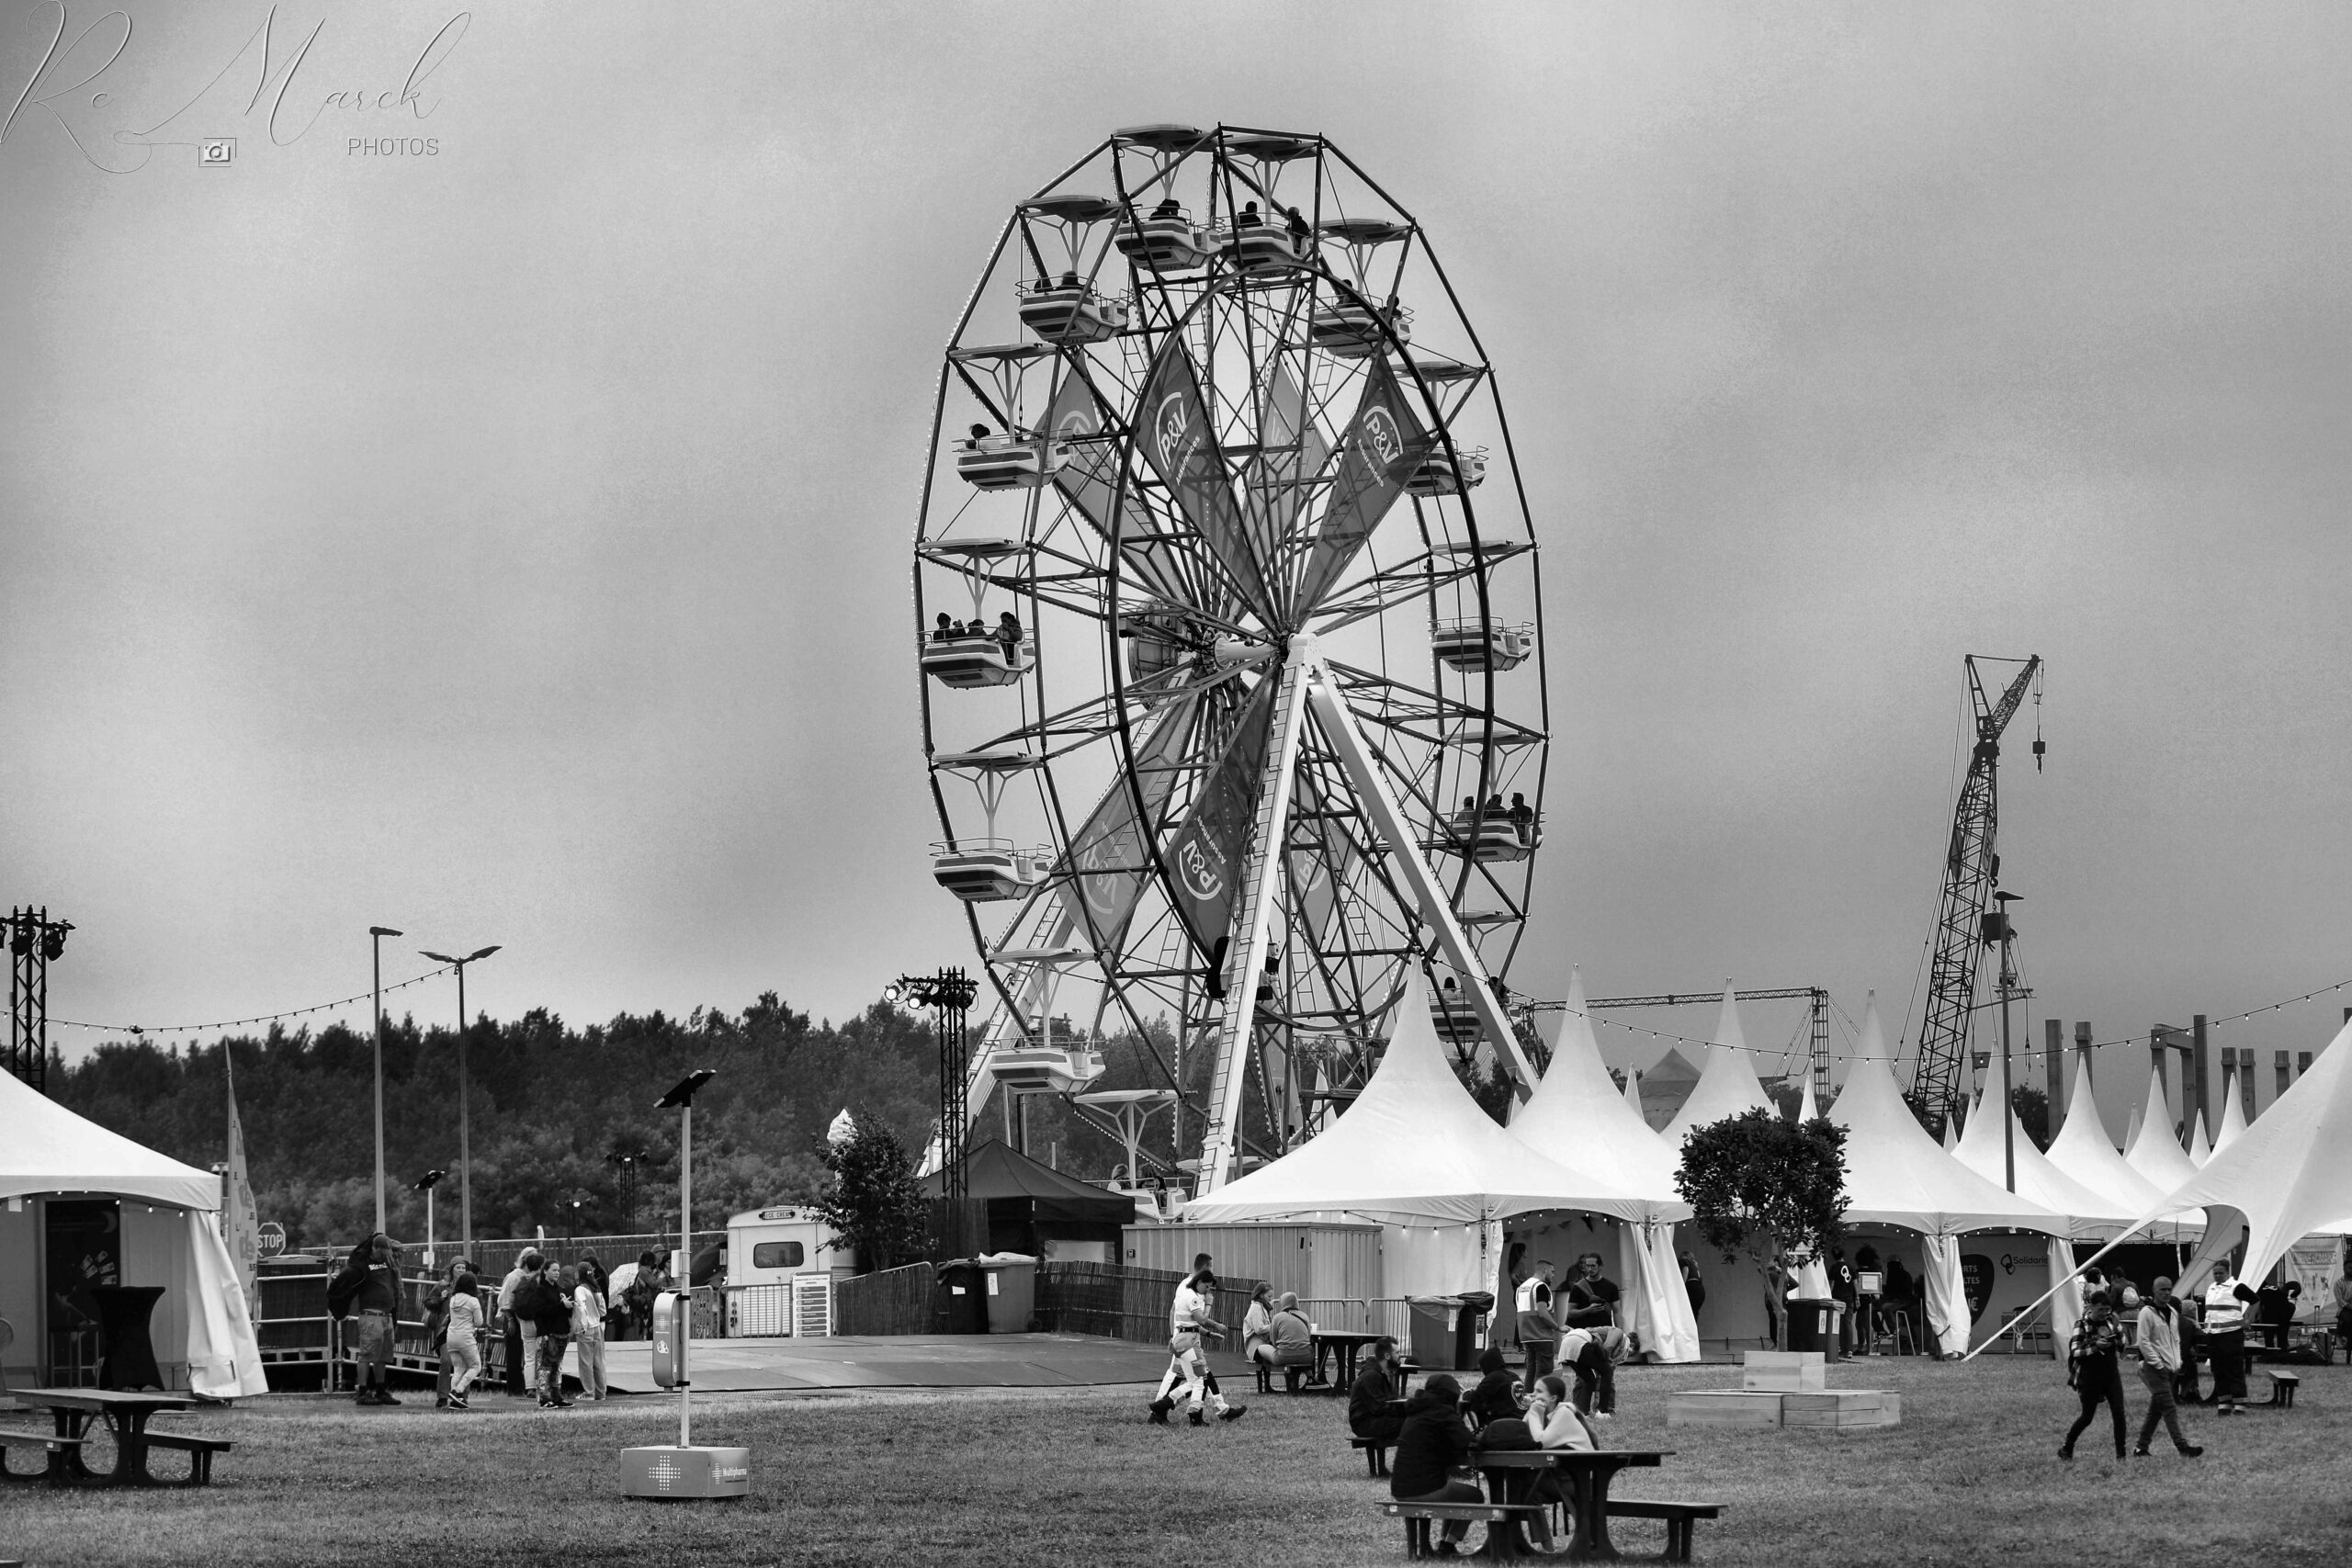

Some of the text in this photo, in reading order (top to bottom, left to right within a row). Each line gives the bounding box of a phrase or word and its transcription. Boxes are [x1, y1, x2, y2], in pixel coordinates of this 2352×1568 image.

[1160, 400, 1188, 465] P&V
[1365, 413, 1400, 465] P&V
[1175, 435, 1201, 486] Assurances
[1182, 839, 1217, 892] P&V
[1197, 815, 1227, 865] Assurances
[258, 1234, 283, 1249] STOP
